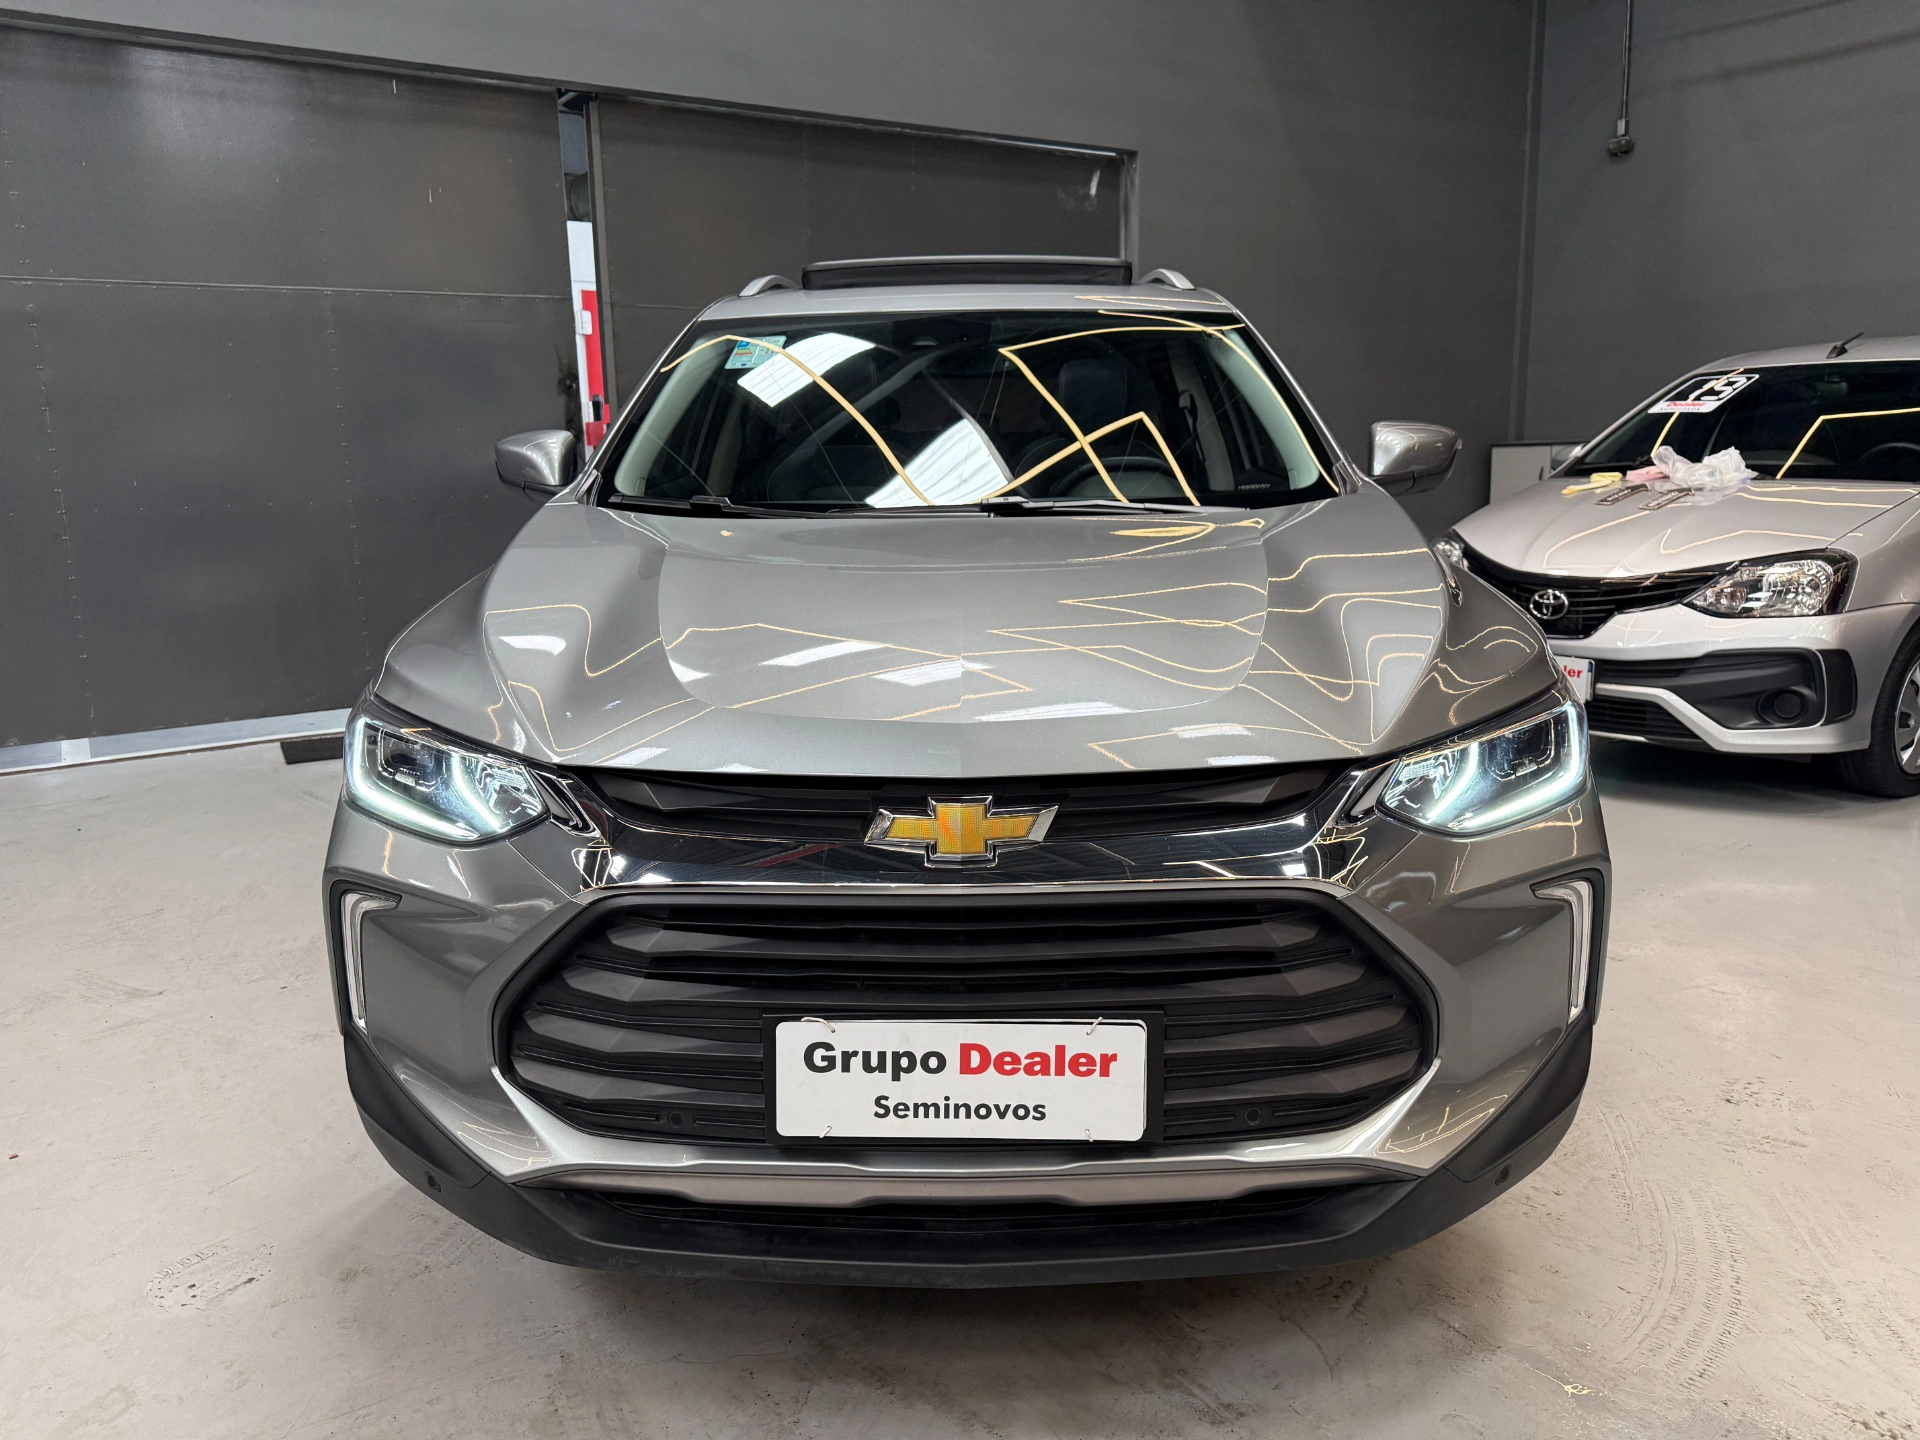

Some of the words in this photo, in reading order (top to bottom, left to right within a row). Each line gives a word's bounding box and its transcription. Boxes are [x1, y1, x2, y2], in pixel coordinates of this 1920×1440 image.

[803, 1041, 947, 1082] Grupo
[959, 1042, 1118, 1078] Dealer
[873, 1094, 1047, 1121] Seminovos
